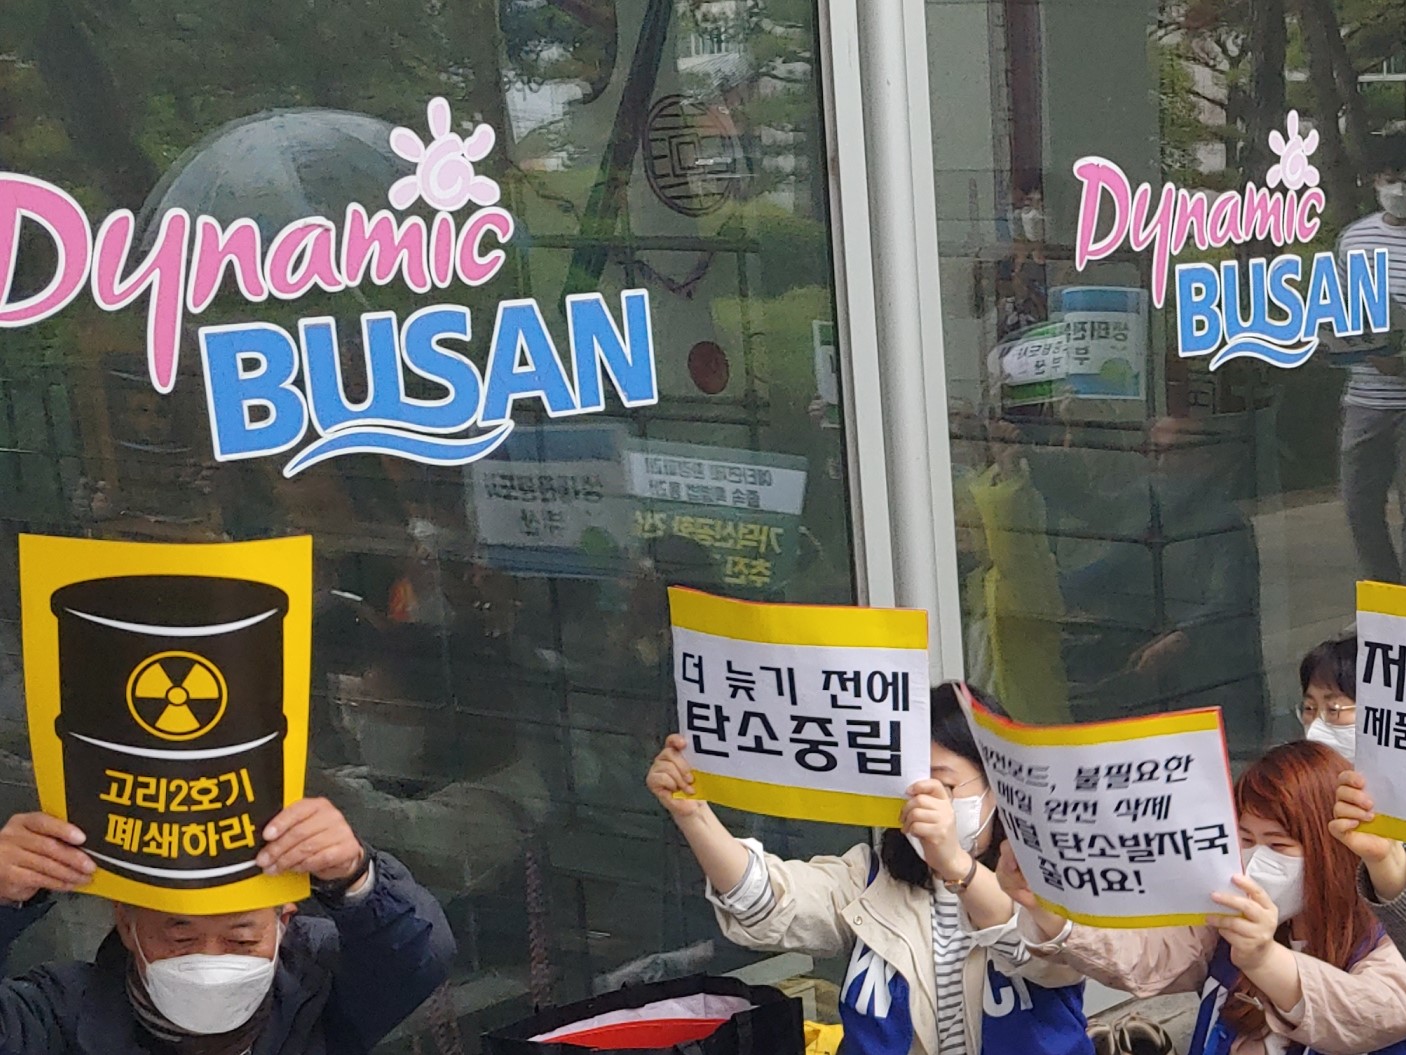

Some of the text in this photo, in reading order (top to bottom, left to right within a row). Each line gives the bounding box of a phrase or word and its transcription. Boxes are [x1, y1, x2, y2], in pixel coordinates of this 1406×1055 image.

[1073, 156, 1326, 309] Dynamic
[0, 172, 514, 393] Dynamic
[1176, 248, 1390, 359] BUSAN
[200, 289, 657, 462] BUSAN
[681, 652, 910, 712] 더 늦기 전에
[685, 698, 902, 777] 탄소중립
[100, 767, 255, 814] 고리2호기
[1075, 754, 1195, 793] 불필요한
[1113, 794, 1172, 822] 삭제
[105, 812, 257, 859] 폐쇄하라
[1050, 823, 1229, 864] 탄소발자국
[1037, 856, 1146, 896] 줄여요!
